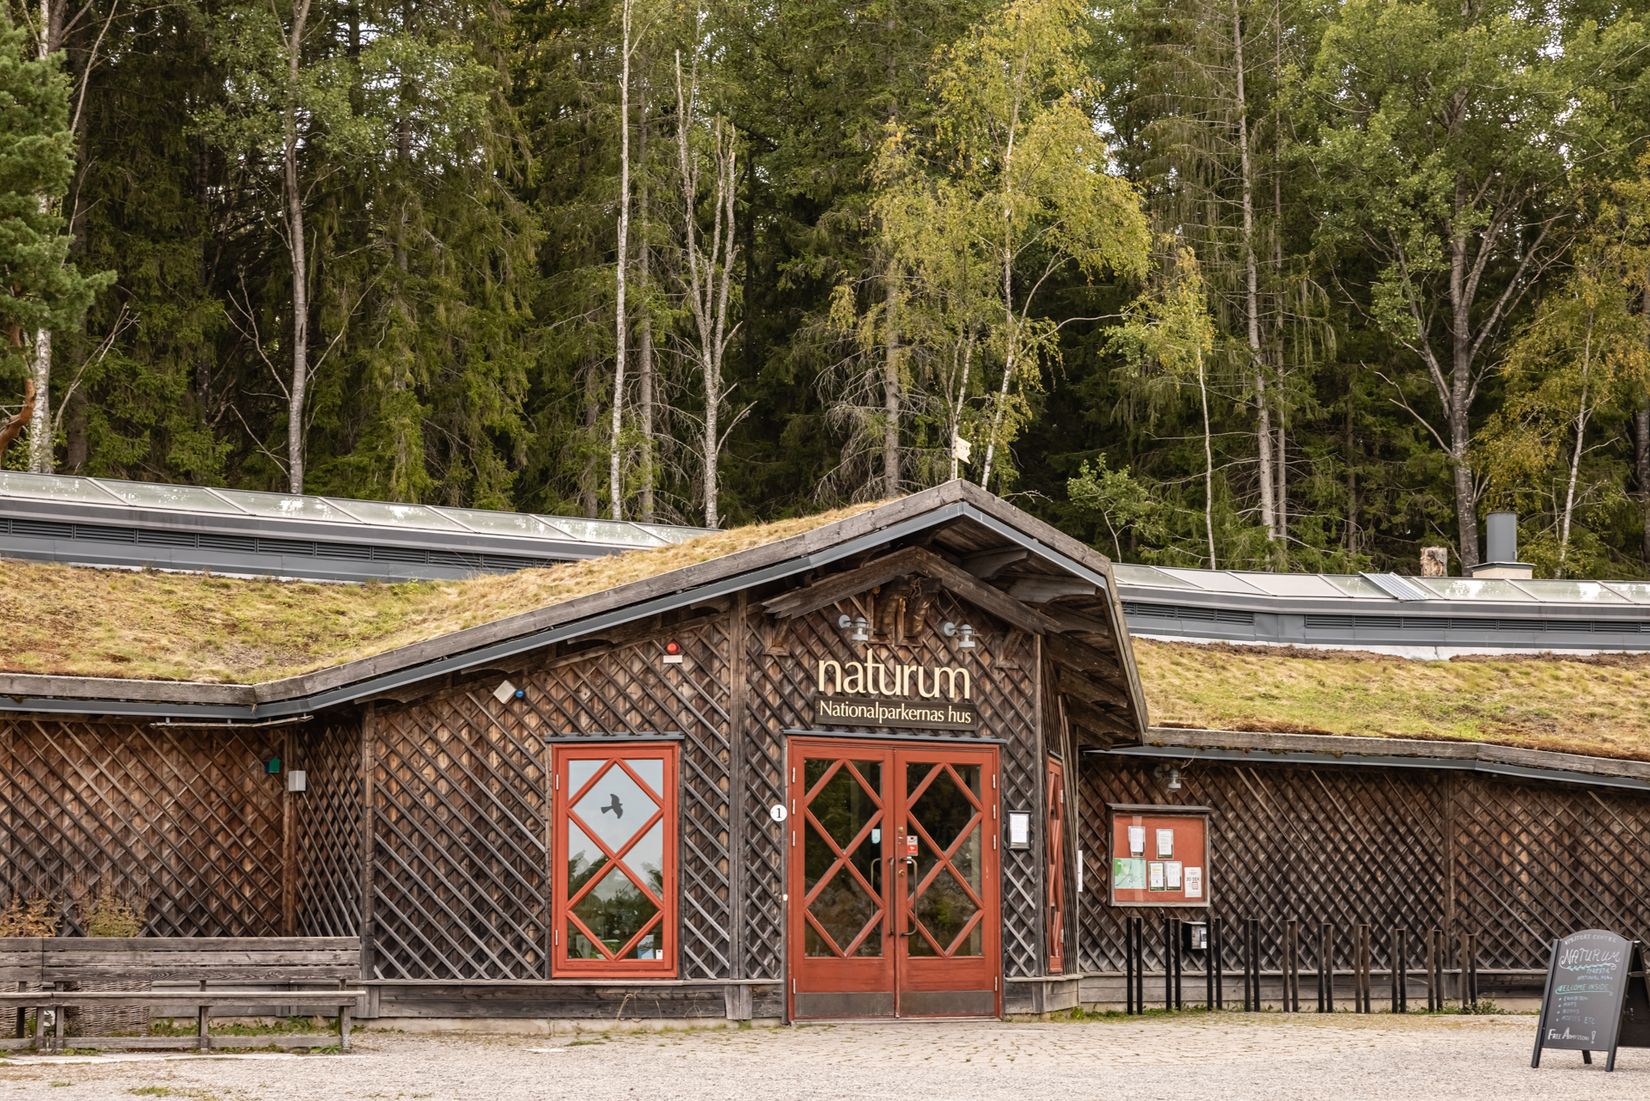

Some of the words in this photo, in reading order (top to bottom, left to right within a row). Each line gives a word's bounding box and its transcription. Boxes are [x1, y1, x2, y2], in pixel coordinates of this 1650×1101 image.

[818, 648, 970, 699] naturum
[819, 700, 945, 724] Nationalparkernas
[948, 706, 972, 724] hus
[1559, 947, 1621, 965] NATURUM
